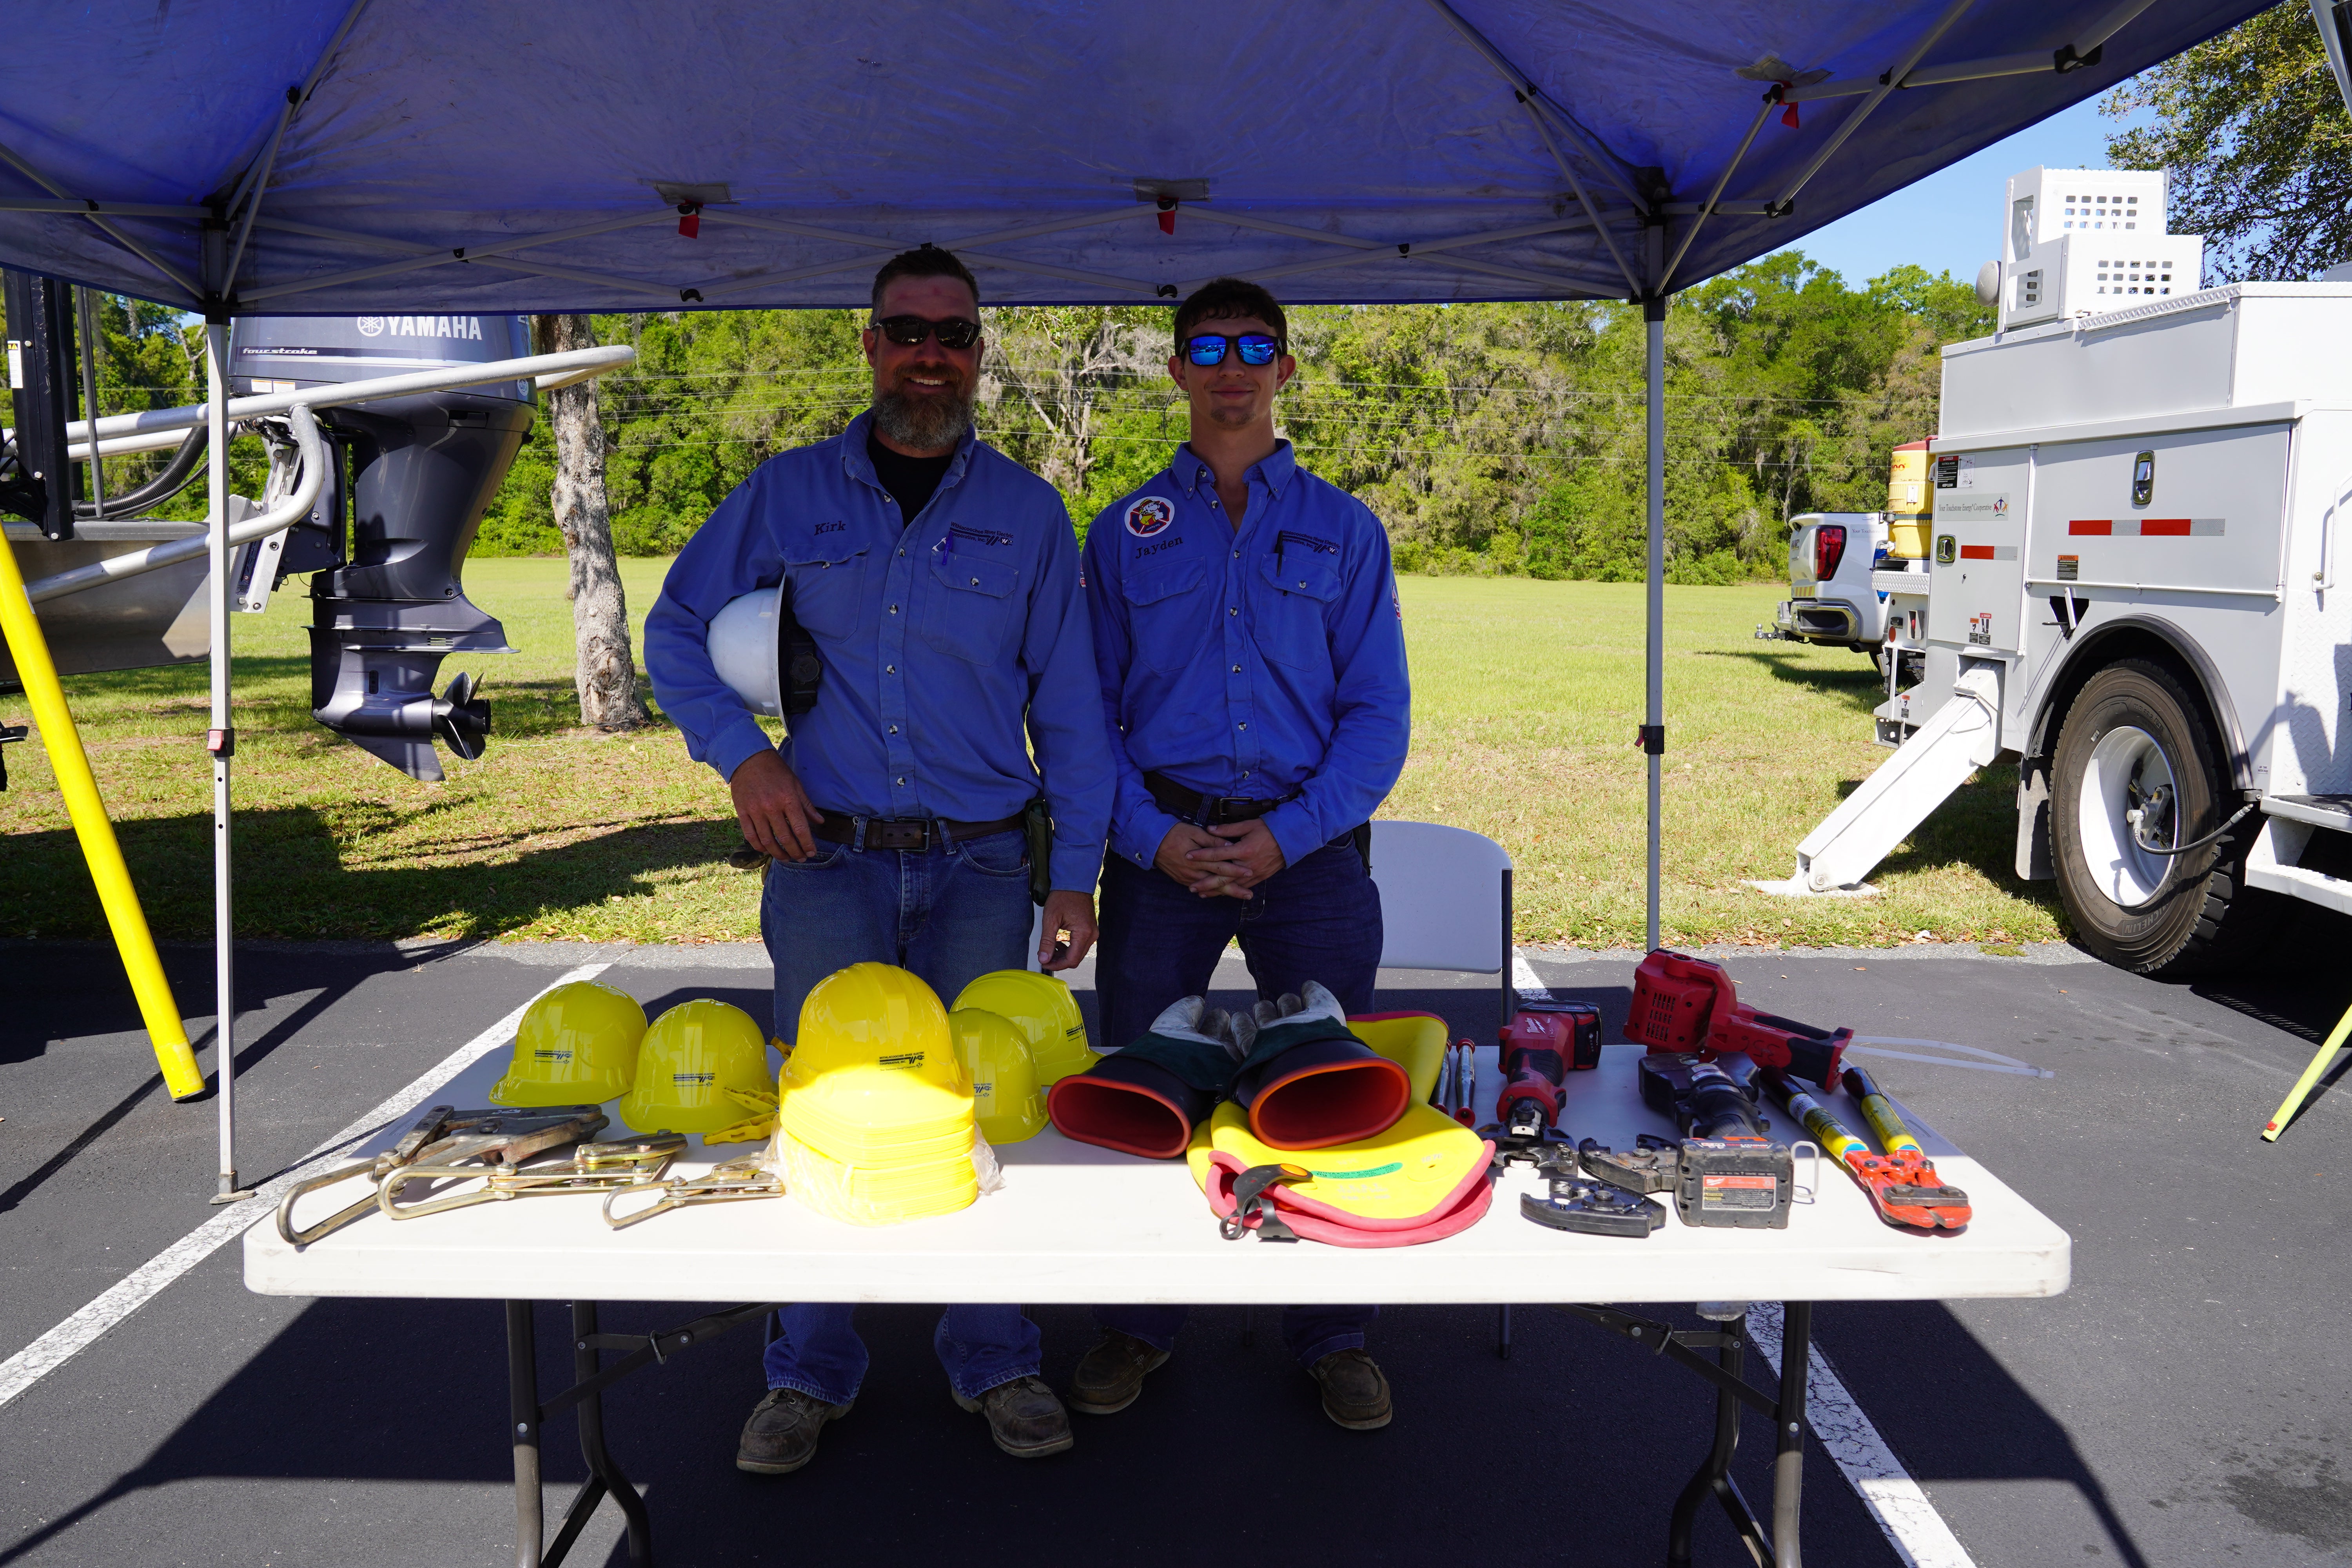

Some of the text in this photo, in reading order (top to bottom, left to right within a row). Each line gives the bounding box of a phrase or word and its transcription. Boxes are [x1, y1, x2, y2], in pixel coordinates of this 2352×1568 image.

[387, 316, 482, 340] YAMAHA
[1973, 503, 1992, 512] Cooperative
[814, 521, 846, 536] Kirk
[951, 521, 984, 534] Withlacoochee
[951, 532, 976, 541] ooperative,
[1135, 537, 1183, 559] Jayden
[1325, 540, 1341, 549] Electric
